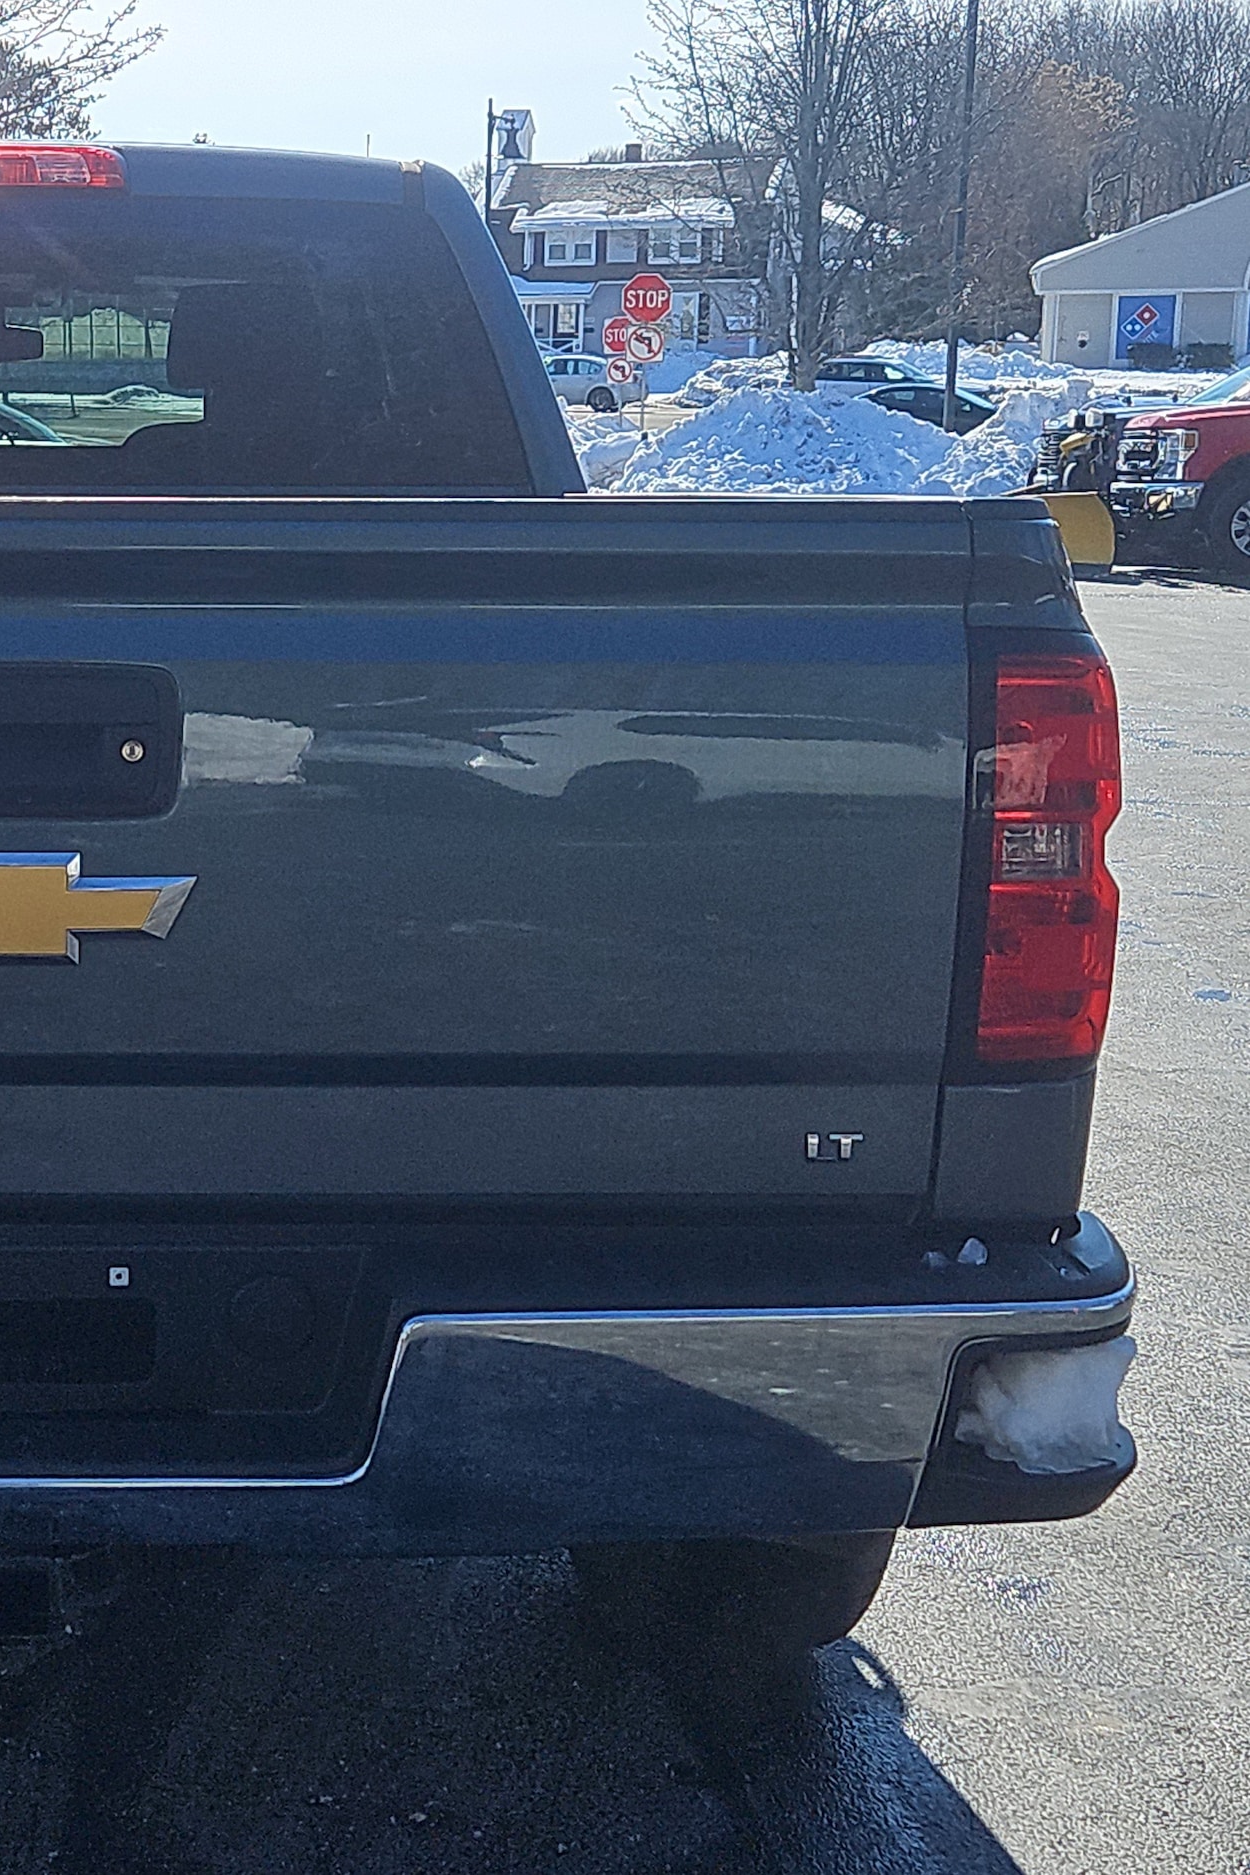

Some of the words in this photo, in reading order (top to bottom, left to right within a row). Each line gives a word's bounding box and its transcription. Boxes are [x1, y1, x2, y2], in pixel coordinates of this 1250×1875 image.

[626, 290, 668, 309] STOP
[605, 328, 627, 342] STO
[806, 1133, 865, 1160] LT
